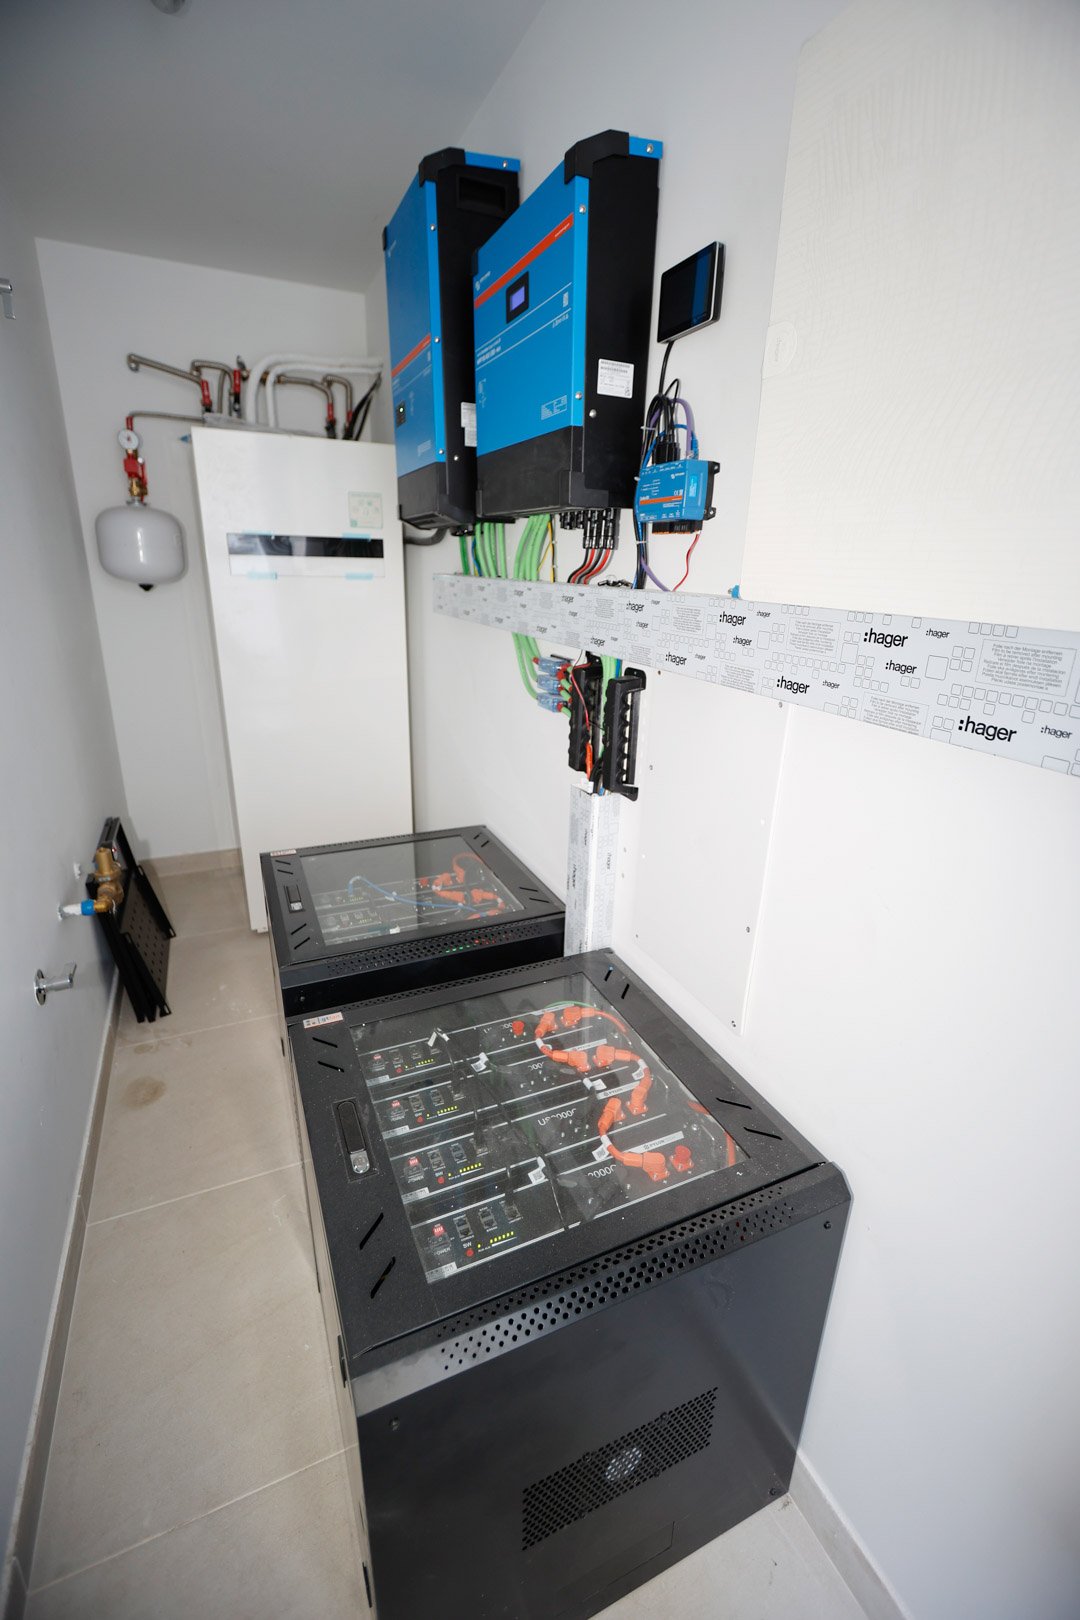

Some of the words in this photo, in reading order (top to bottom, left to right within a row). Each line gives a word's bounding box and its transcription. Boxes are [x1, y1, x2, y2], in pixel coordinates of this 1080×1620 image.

[625, 602, 645, 614] :hager
[720, 612, 746, 626] :hager
[864, 628, 908, 648] :hager
[926, 629, 949, 638] :hager
[732, 635, 753, 647] :hager
[665, 653, 687, 666] :hager
[886, 660, 917, 674] :hager
[777, 676, 810, 694] :hager
[958, 716, 1017, 742] :hager
[1041, 726, 1072, 738] :hager
